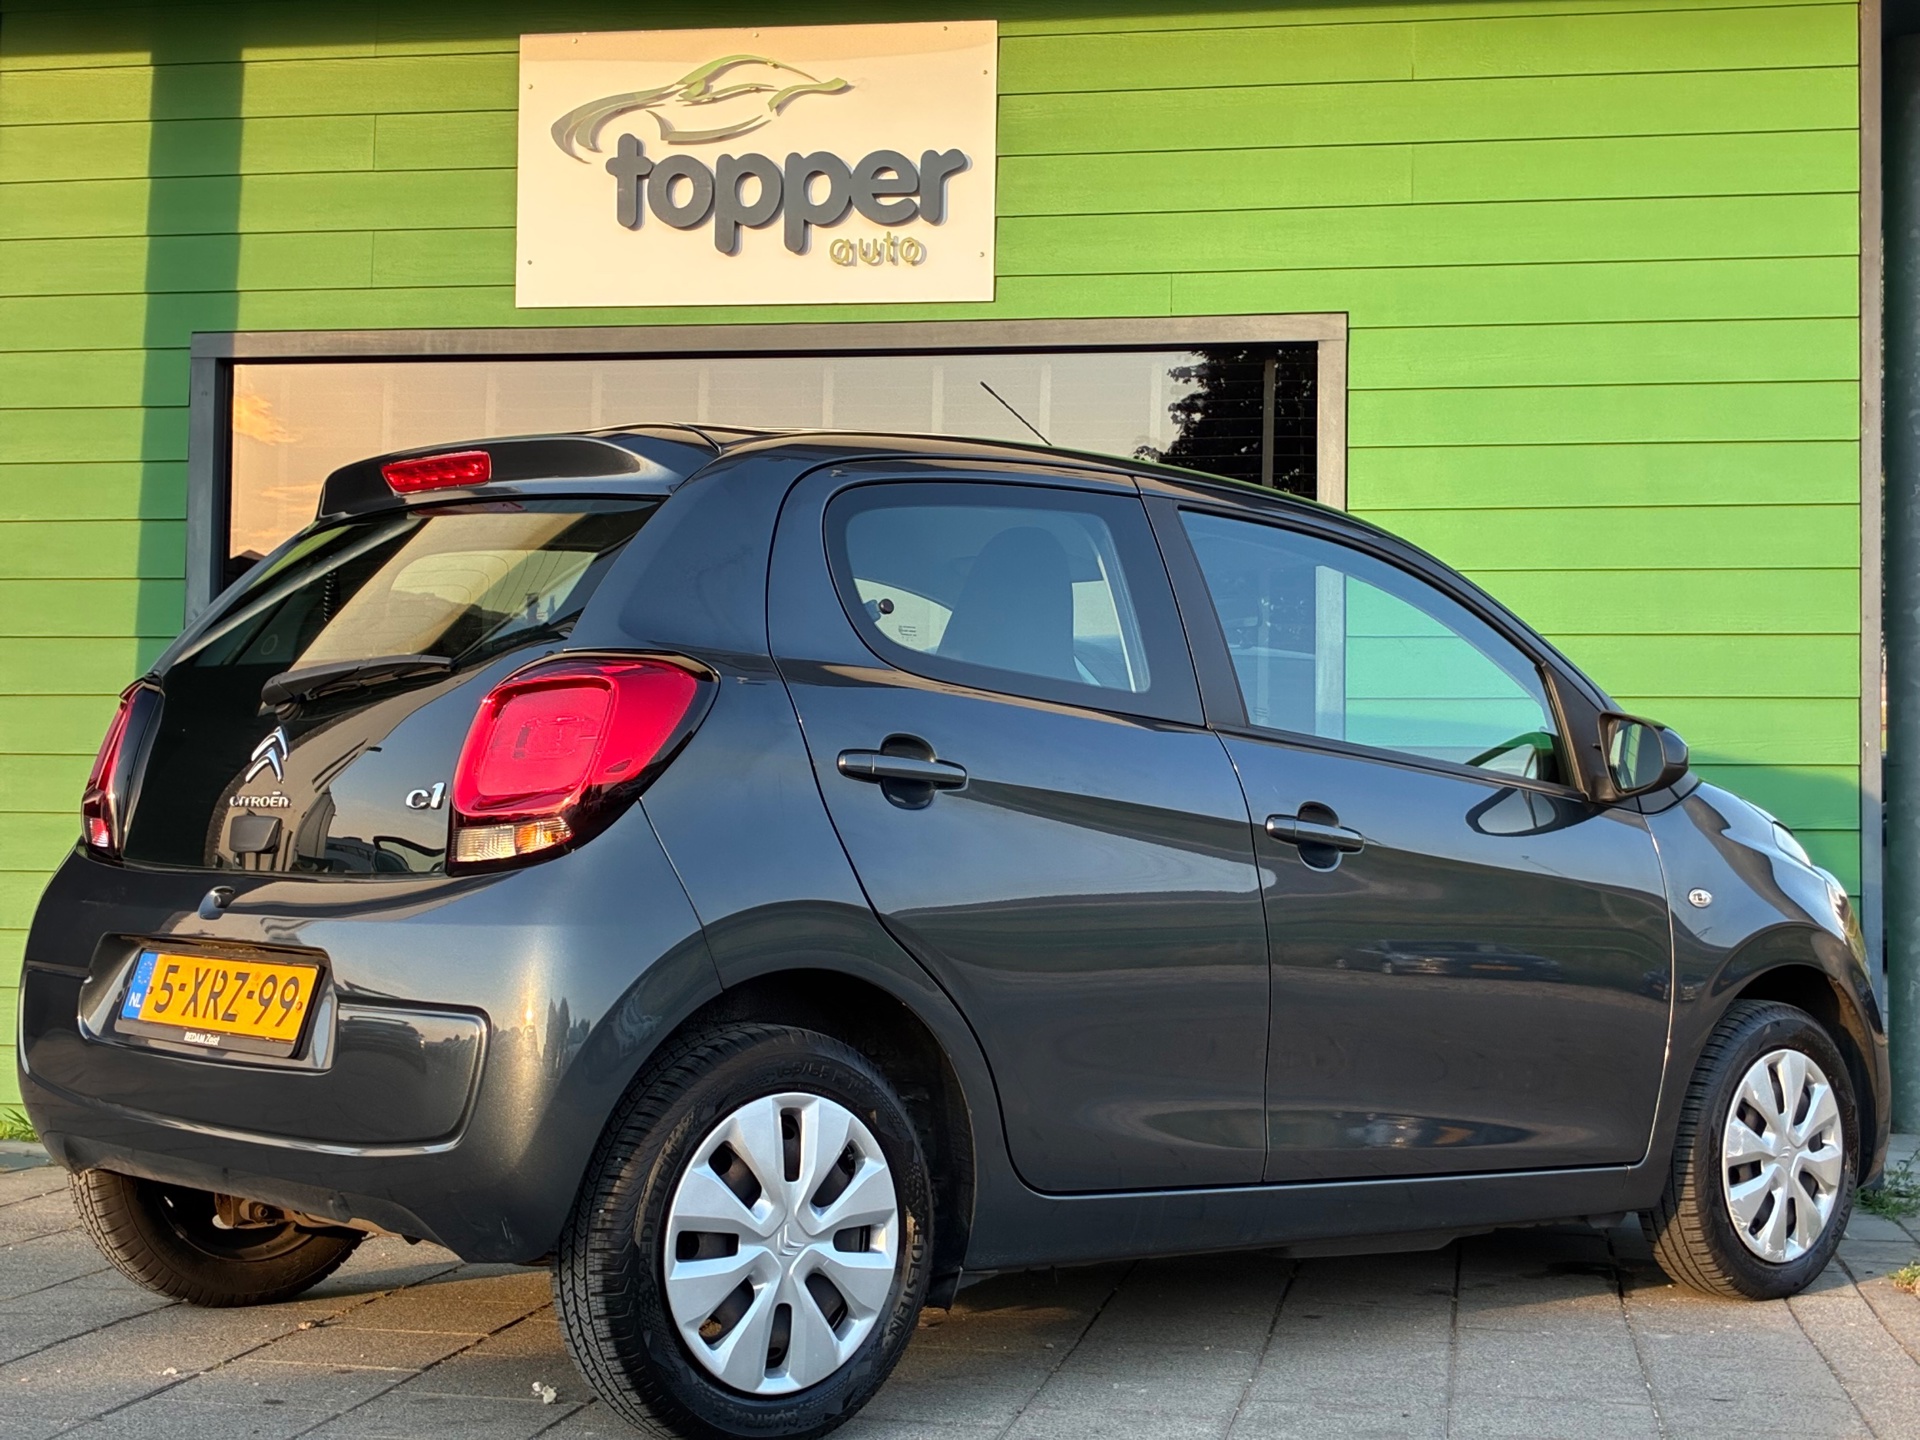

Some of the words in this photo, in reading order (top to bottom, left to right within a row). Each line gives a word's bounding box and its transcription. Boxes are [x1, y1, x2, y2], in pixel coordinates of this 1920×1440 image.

[605, 133, 967, 254] topper
[829, 231, 922, 265] auto
[128, 991, 142, 1008] NL
[153, 964, 300, 1028] 5-XRZ-99
